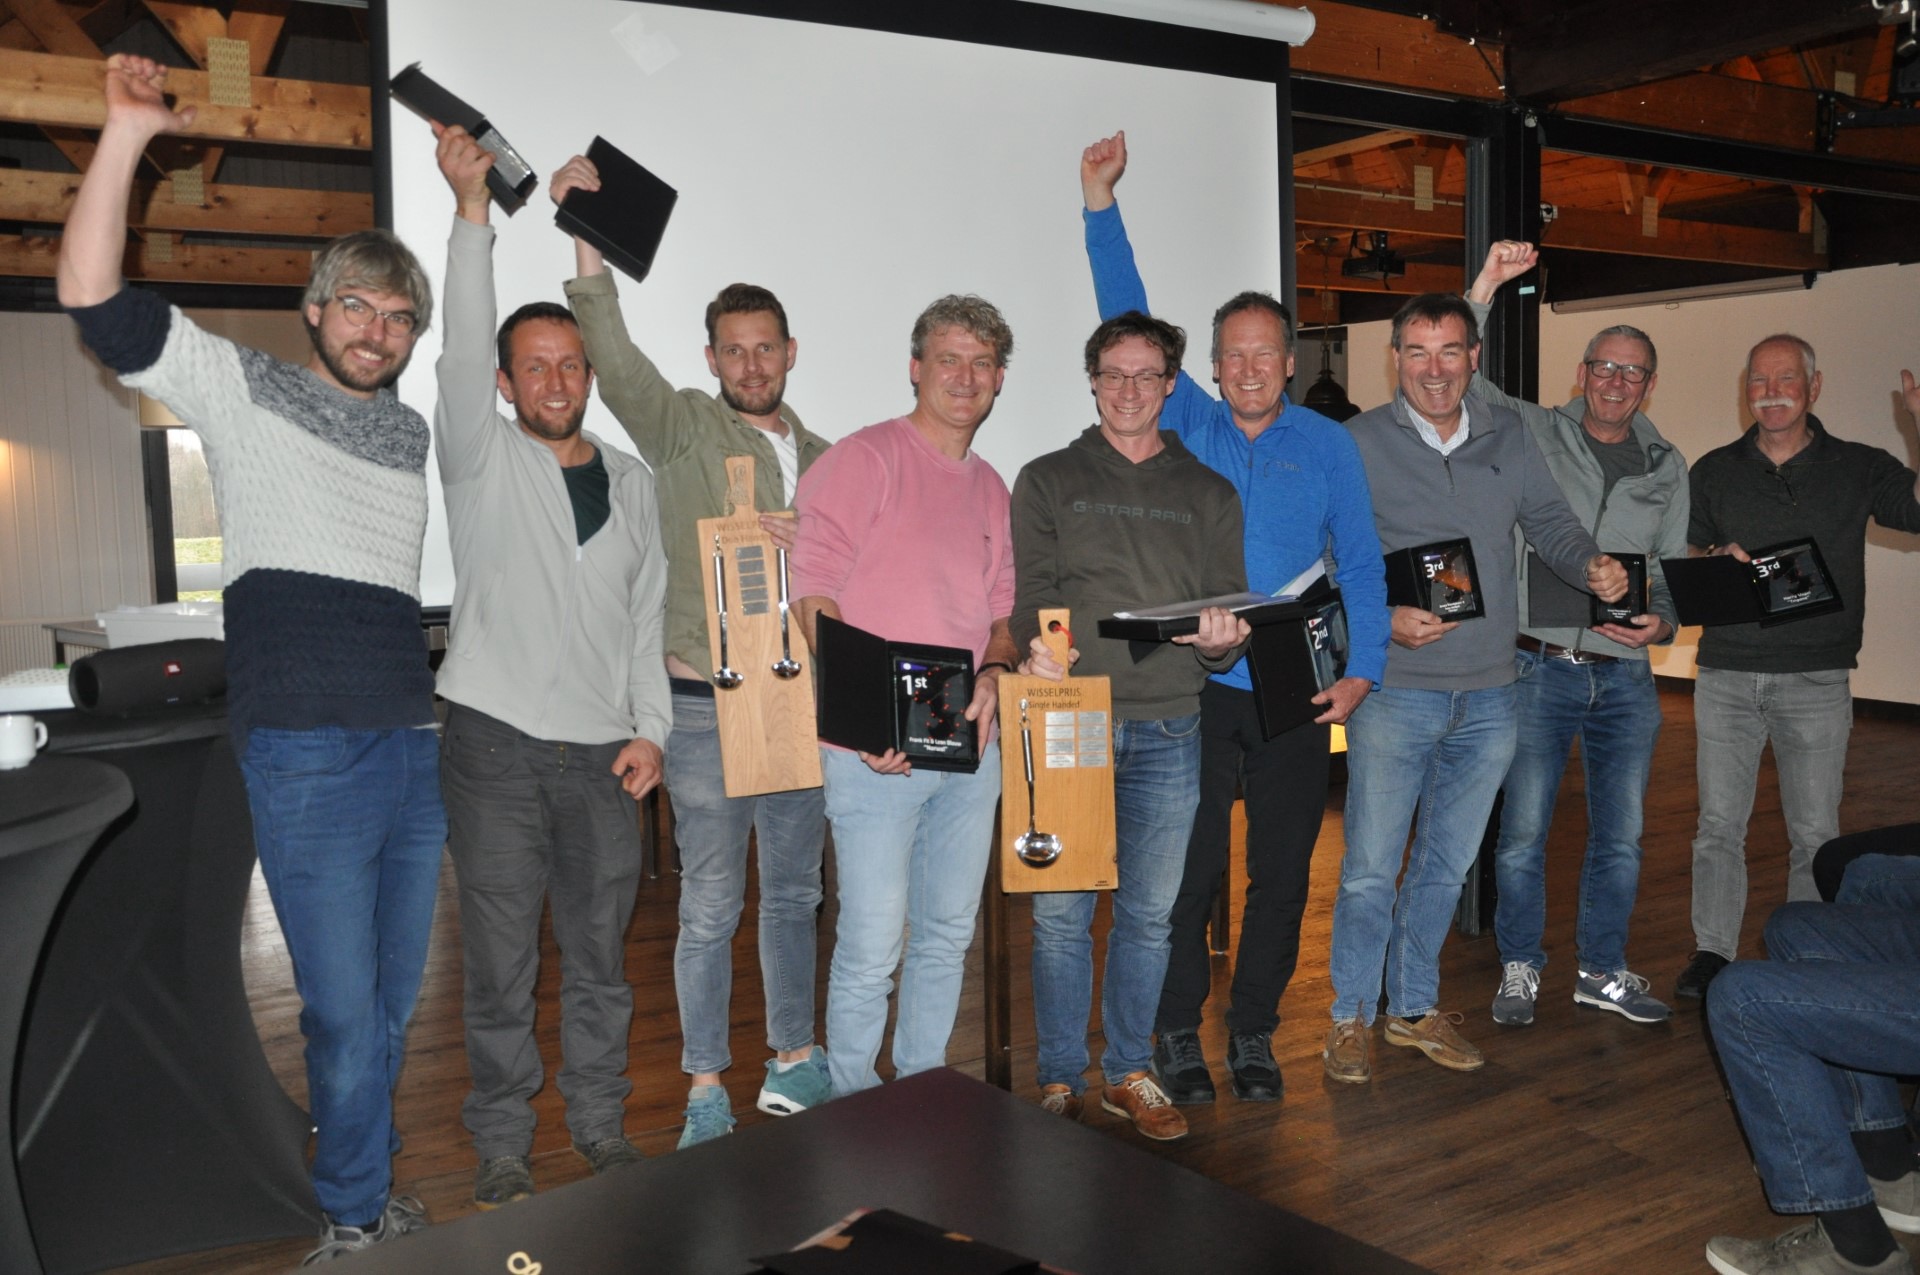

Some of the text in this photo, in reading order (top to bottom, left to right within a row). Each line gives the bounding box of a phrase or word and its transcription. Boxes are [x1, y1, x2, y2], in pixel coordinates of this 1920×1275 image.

[1073, 501, 1191, 524] G-STAR RAW
[1425, 561, 1444, 578] 3rd
[1756, 561, 1780, 578] 3rd
[1312, 626, 1328, 650] 2nd
[901, 675, 927, 695] 1st
[1027, 687, 1082, 697] WISSELPRIJS
[1052, 700, 1080, 709] Handed
